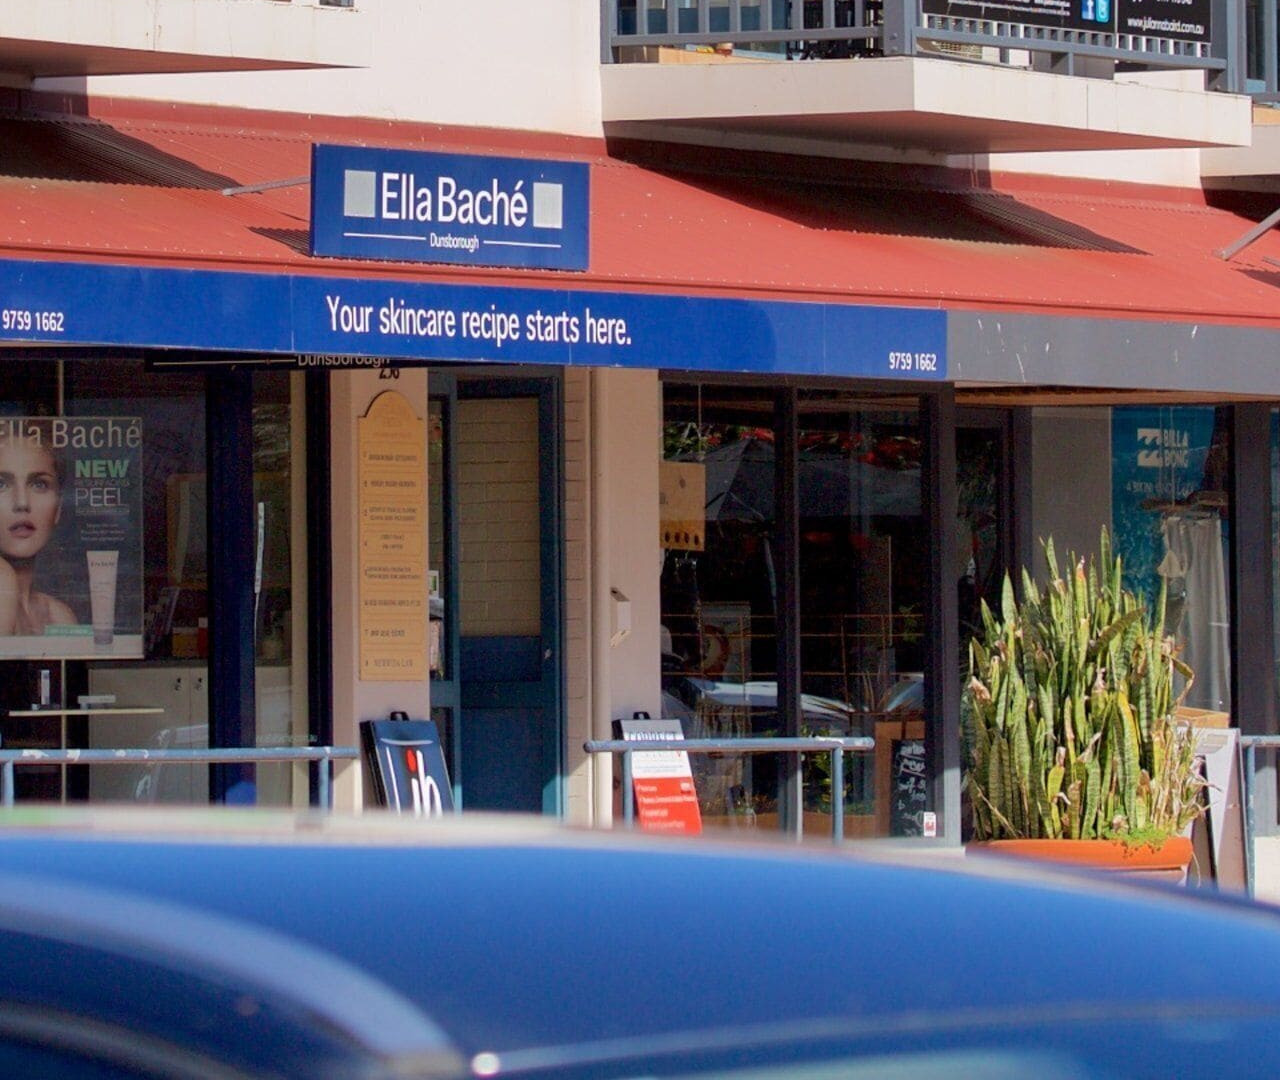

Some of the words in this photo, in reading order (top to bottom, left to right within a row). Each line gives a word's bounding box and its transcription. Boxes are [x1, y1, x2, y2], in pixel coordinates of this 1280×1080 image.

[381, 171, 433, 221] Ella
[437, 176, 529, 227] Baché
[429, 232, 480, 253] Dunsborough
[2, 310, 32, 331] 9759
[34, 311, 65, 332] 1662
[326, 294, 373, 333] Your
[379, 296, 457, 338] skincare
[462, 303, 520, 347] recipe
[525, 308, 580, 342] starts
[585, 307, 632, 345] here.
[888, 351, 913, 370] 9759
[913, 352, 938, 372] 1662
[52, 418, 142, 449] Baché
[75, 459, 131, 479] NEW
[75, 487, 122, 507] PEEL
